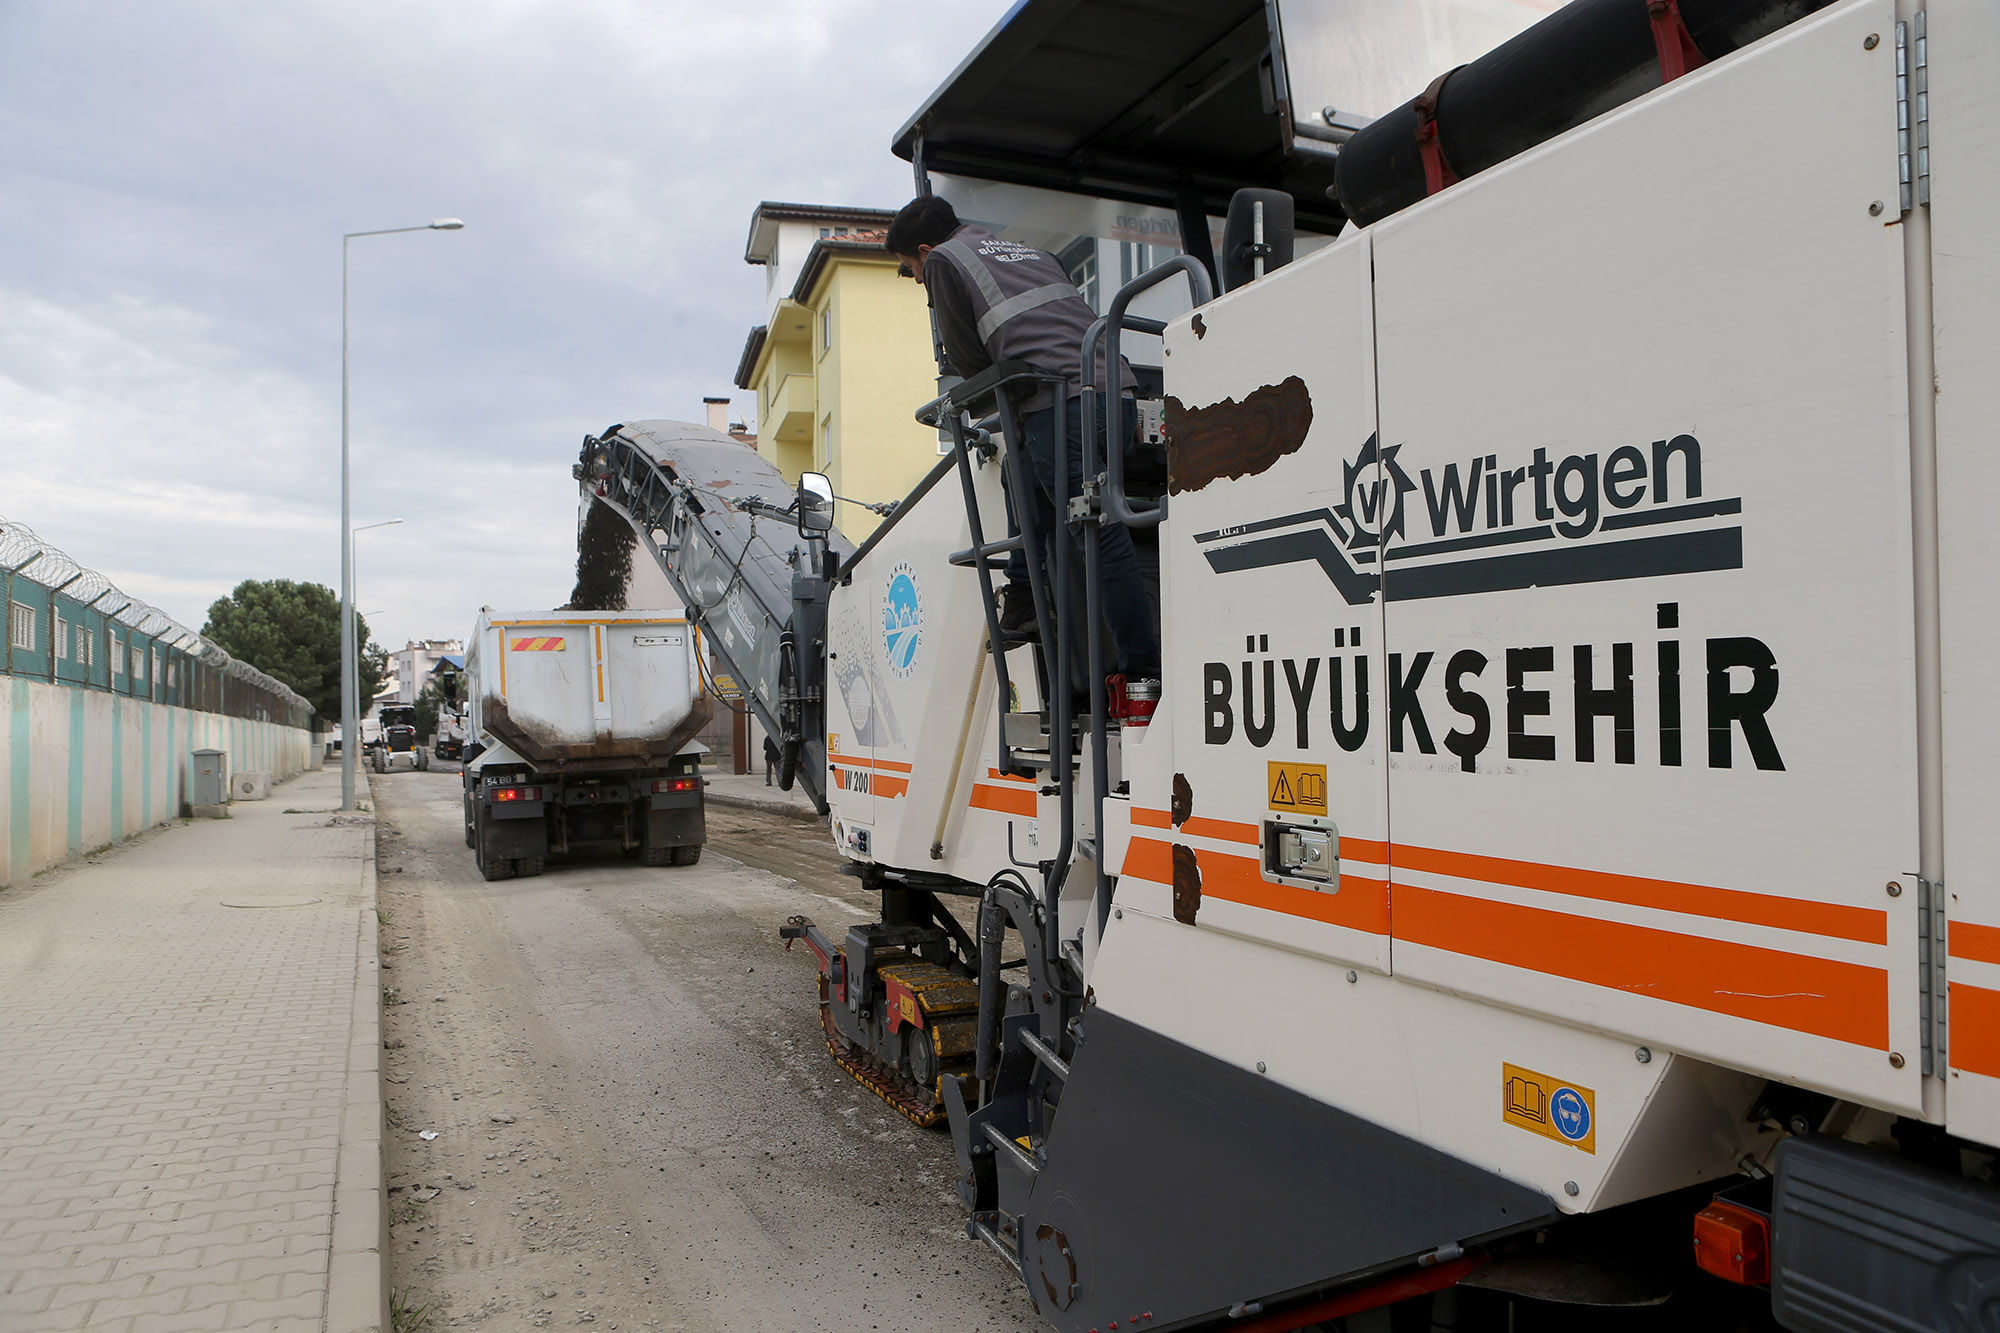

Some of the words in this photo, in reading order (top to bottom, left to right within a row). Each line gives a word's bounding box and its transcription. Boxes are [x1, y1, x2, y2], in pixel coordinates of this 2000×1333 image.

[1420, 433, 1703, 540] Wirtgen
[1203, 601, 1787, 774] BÜYÜKŞEHİR
[845, 769, 853, 791] W
[853, 771, 869, 794] 200
